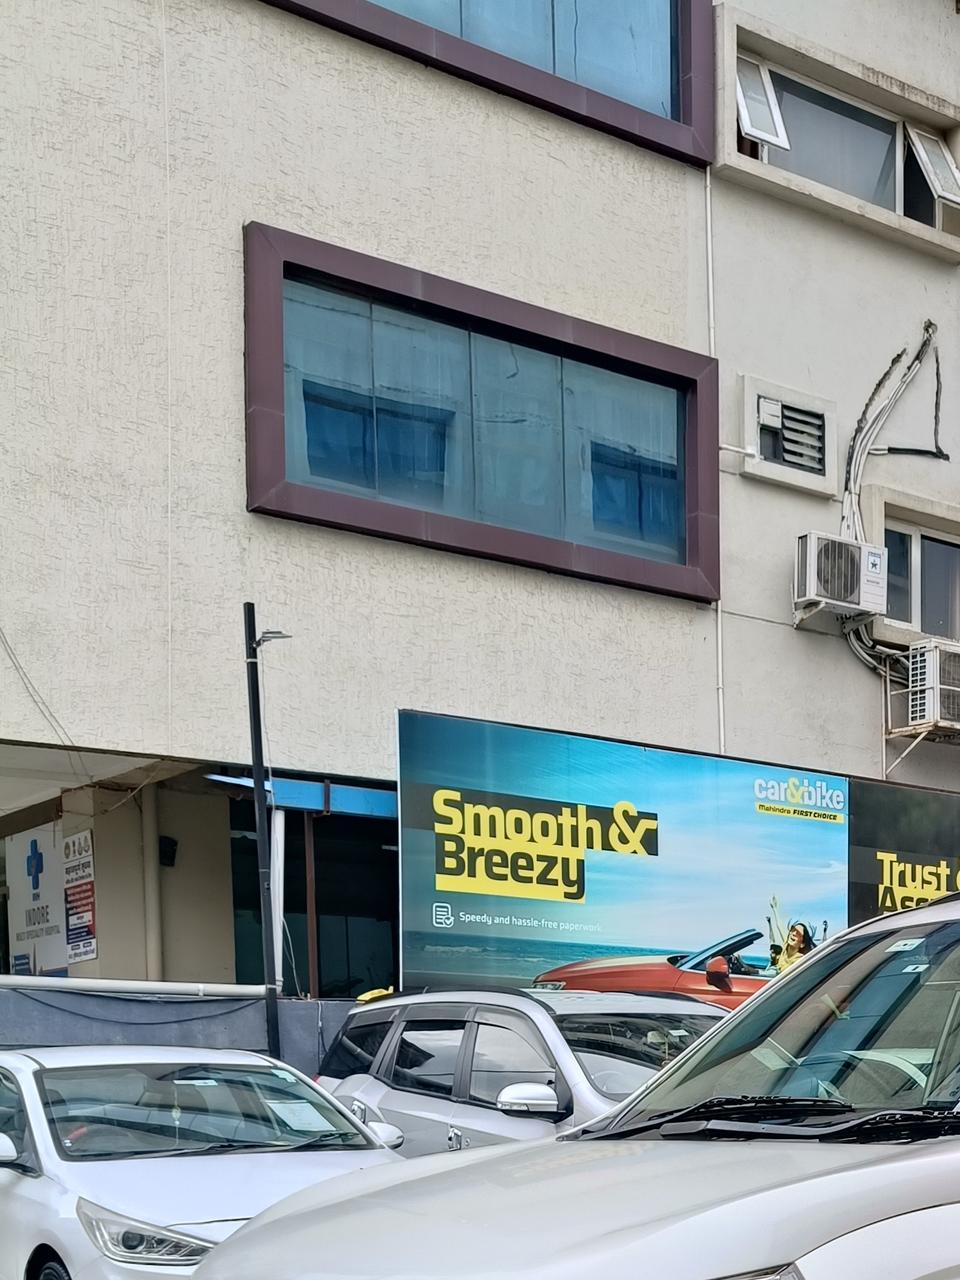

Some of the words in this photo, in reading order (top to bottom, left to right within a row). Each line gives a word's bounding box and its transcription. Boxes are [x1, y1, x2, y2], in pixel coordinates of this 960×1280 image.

[754, 777, 845, 810] car&bike
[432, 789, 602, 851] Smooth
[608, 800, 658, 856] &
[758, 804, 791, 815] Mahindra
[793, 809, 813, 817] FIRST
[813, 811, 837, 820] CHOICE
[435, 833, 585, 900] Breezy
[876, 851, 951, 893] Trust
[25, 904, 50, 927] INDORE
[459, 911, 492, 925] Speedy
[494, 913, 510, 925] and
[511, 915, 558, 929] hassle-free
[559, 921, 602, 932] paperwork
